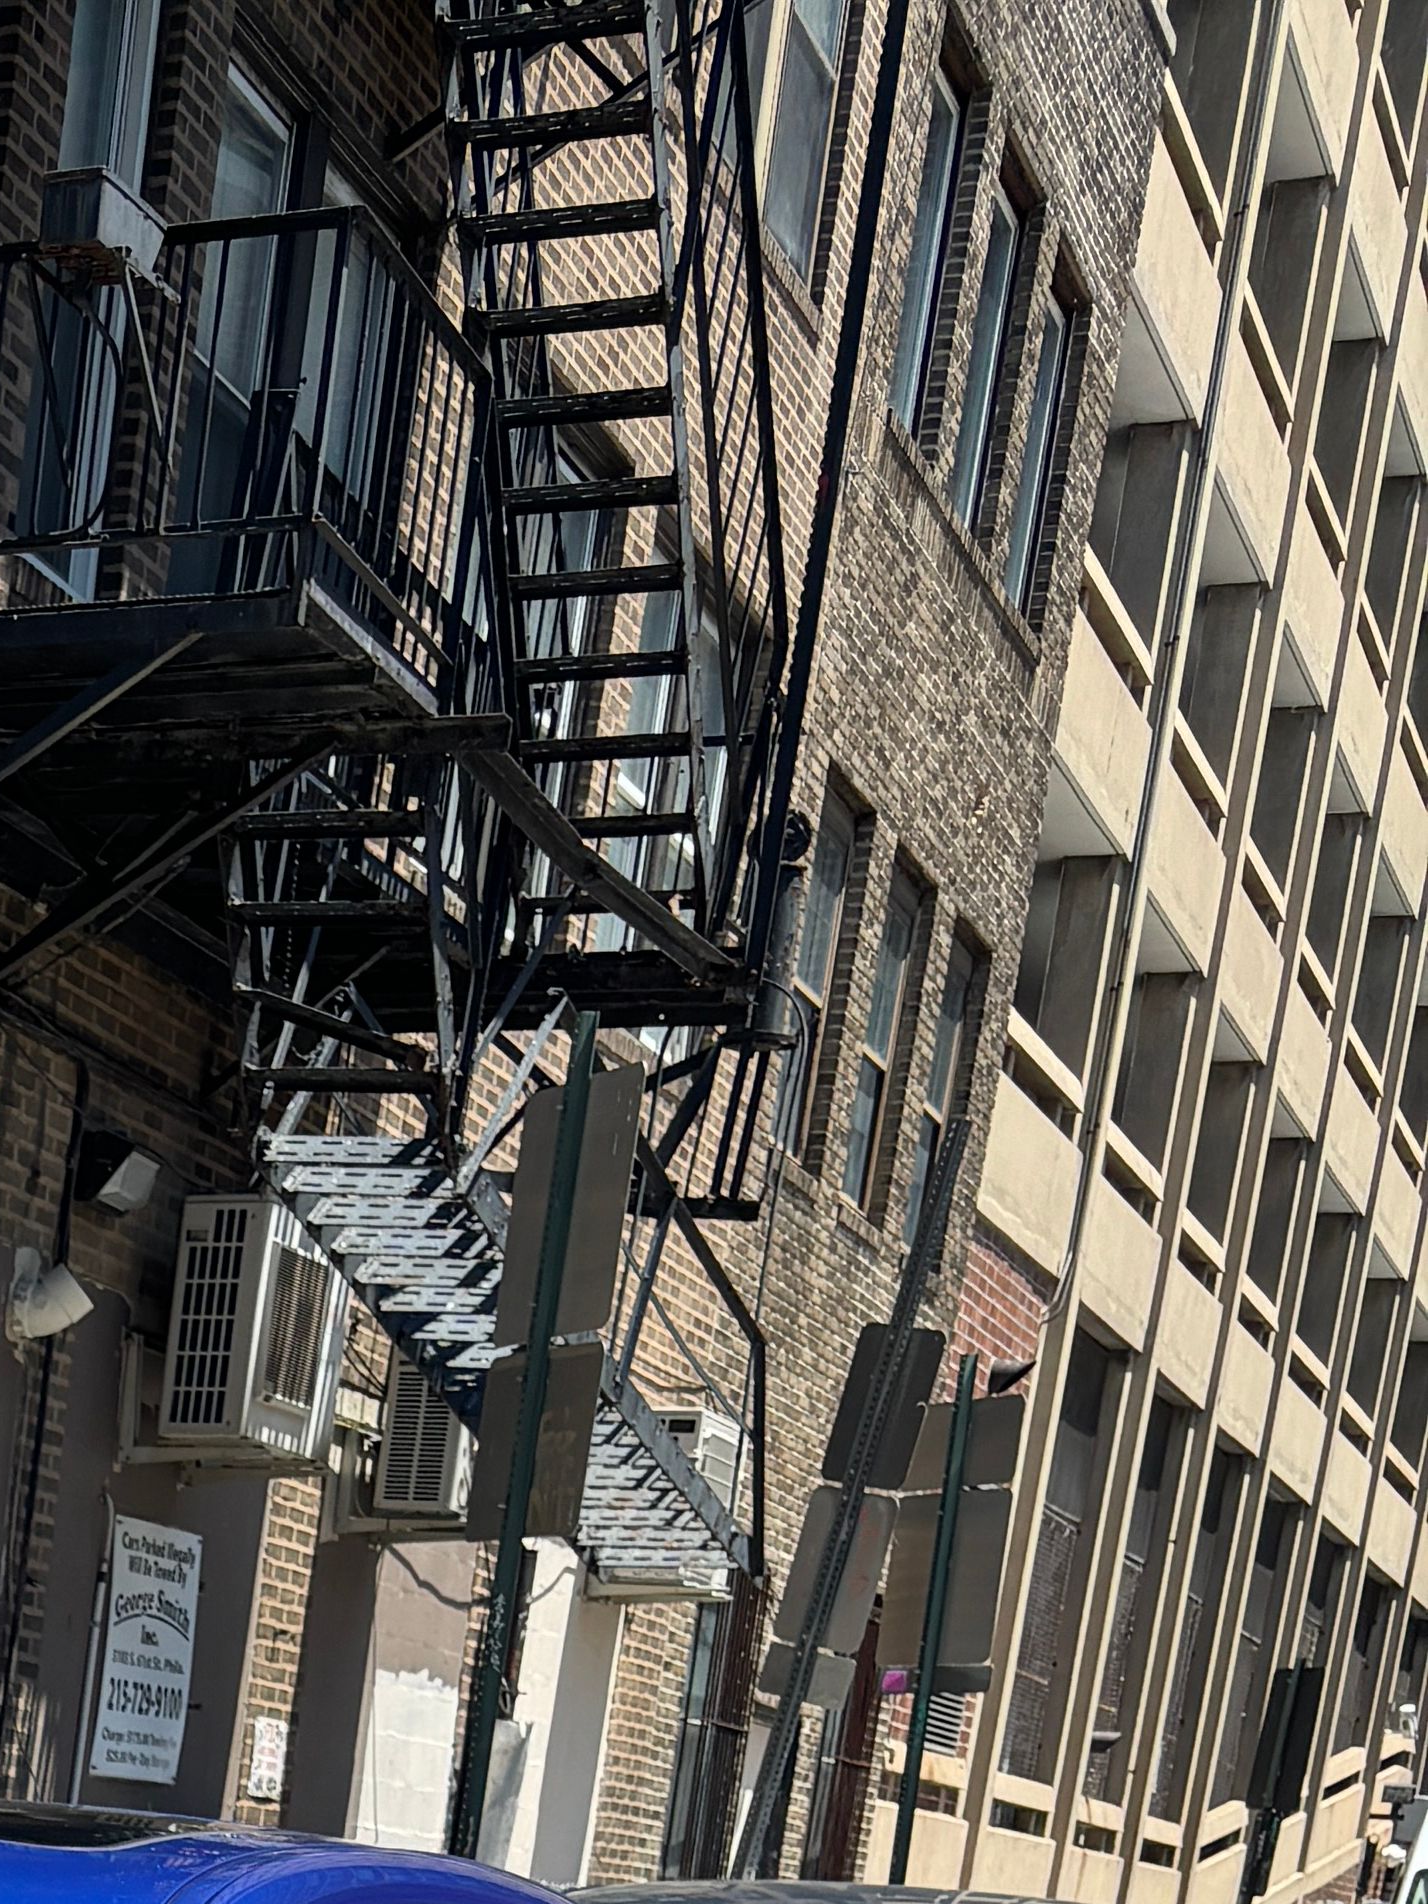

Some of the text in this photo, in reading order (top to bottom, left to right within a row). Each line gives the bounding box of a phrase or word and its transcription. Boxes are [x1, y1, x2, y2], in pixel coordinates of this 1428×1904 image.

[122, 1531, 140, 1552] Cars
[115, 1589, 190, 1634] George Smith
[107, 1676, 183, 1721] 215-729-9100
